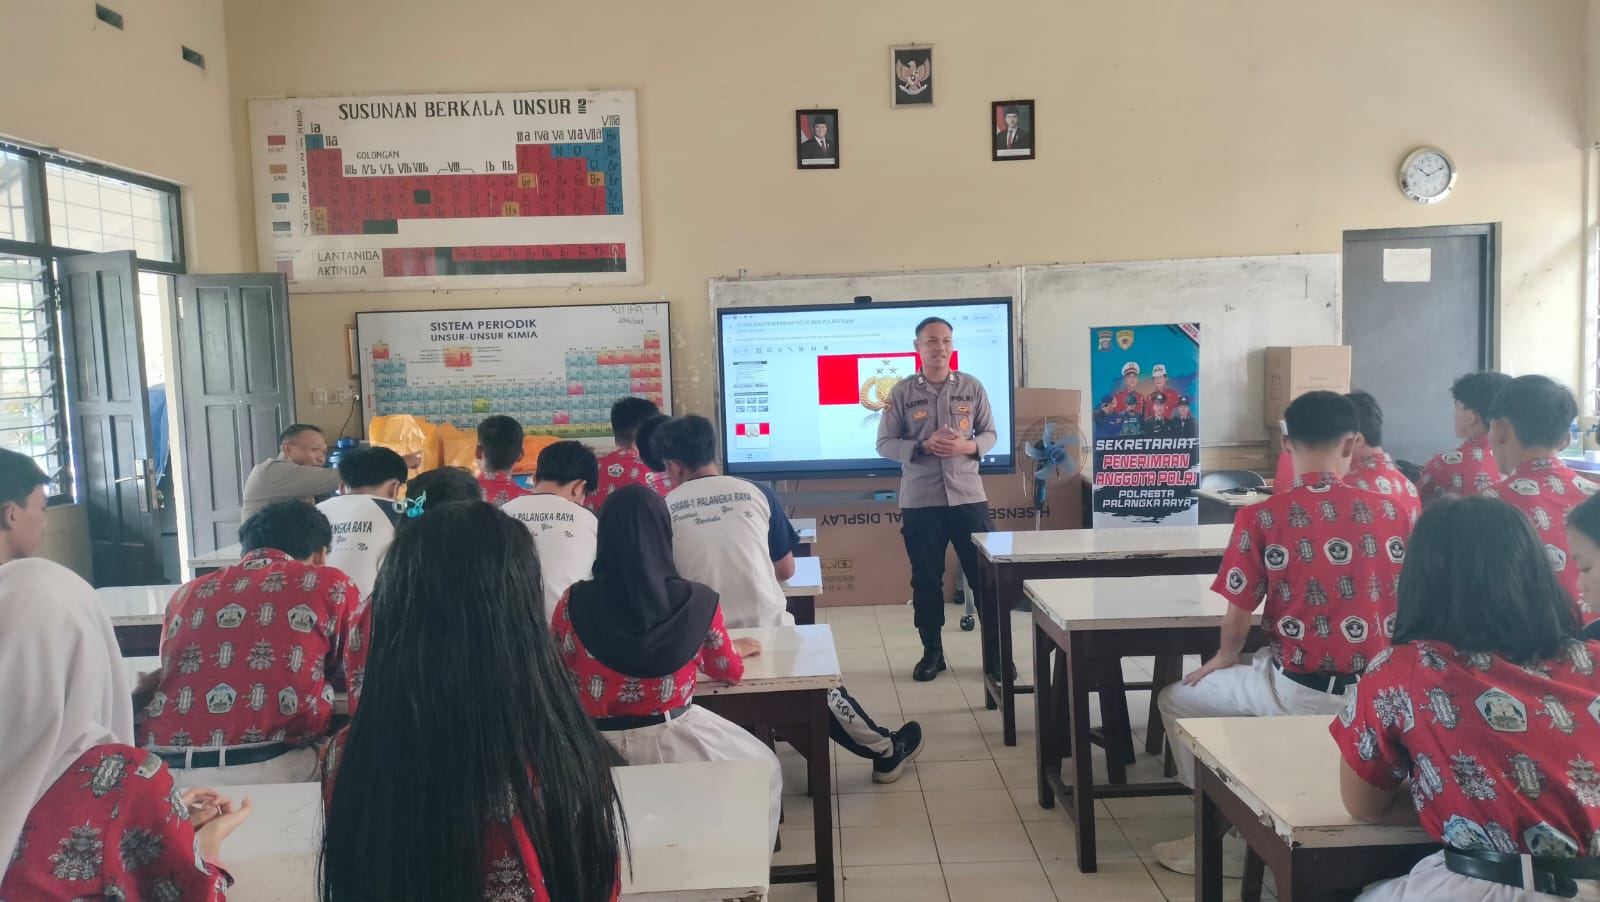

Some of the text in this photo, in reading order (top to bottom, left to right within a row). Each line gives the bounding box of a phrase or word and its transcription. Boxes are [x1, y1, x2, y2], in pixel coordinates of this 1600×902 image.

[338, 101, 417, 120] SUSUNAN
[425, 100, 505, 118] BERKALA
[513, 98, 571, 115] UNSUR
[356, 150, 400, 160] GOLONGAN
[318, 250, 380, 262] LANTANIDA
[317, 264, 368, 276] AKTINIDA
[430, 320, 536, 332] SISTEM PERIODIK
[431, 331, 538, 342] UNSUR-UNSUR KIMIA
[1096, 438, 1196, 451] SEKRETARIAT
[1102, 453, 1190, 469] PENERIMAAN
[1096, 470, 1198, 487] ANGGOTA POLRI
[697, 494, 734, 506] PALANGKA
[734, 492, 752, 502] RAYA
[1118, 489, 1175, 499] POLRESTA
[1102, 498, 1192, 508] PALANGKA RAYA
[518, 512, 554, 522] PALANGKA
[555, 512, 574, 522] RAYA
[821, 512, 880, 526] DISPLAY
[988, 507, 1050, 520] HSENSE
[352, 520, 372, 534] RAYA
